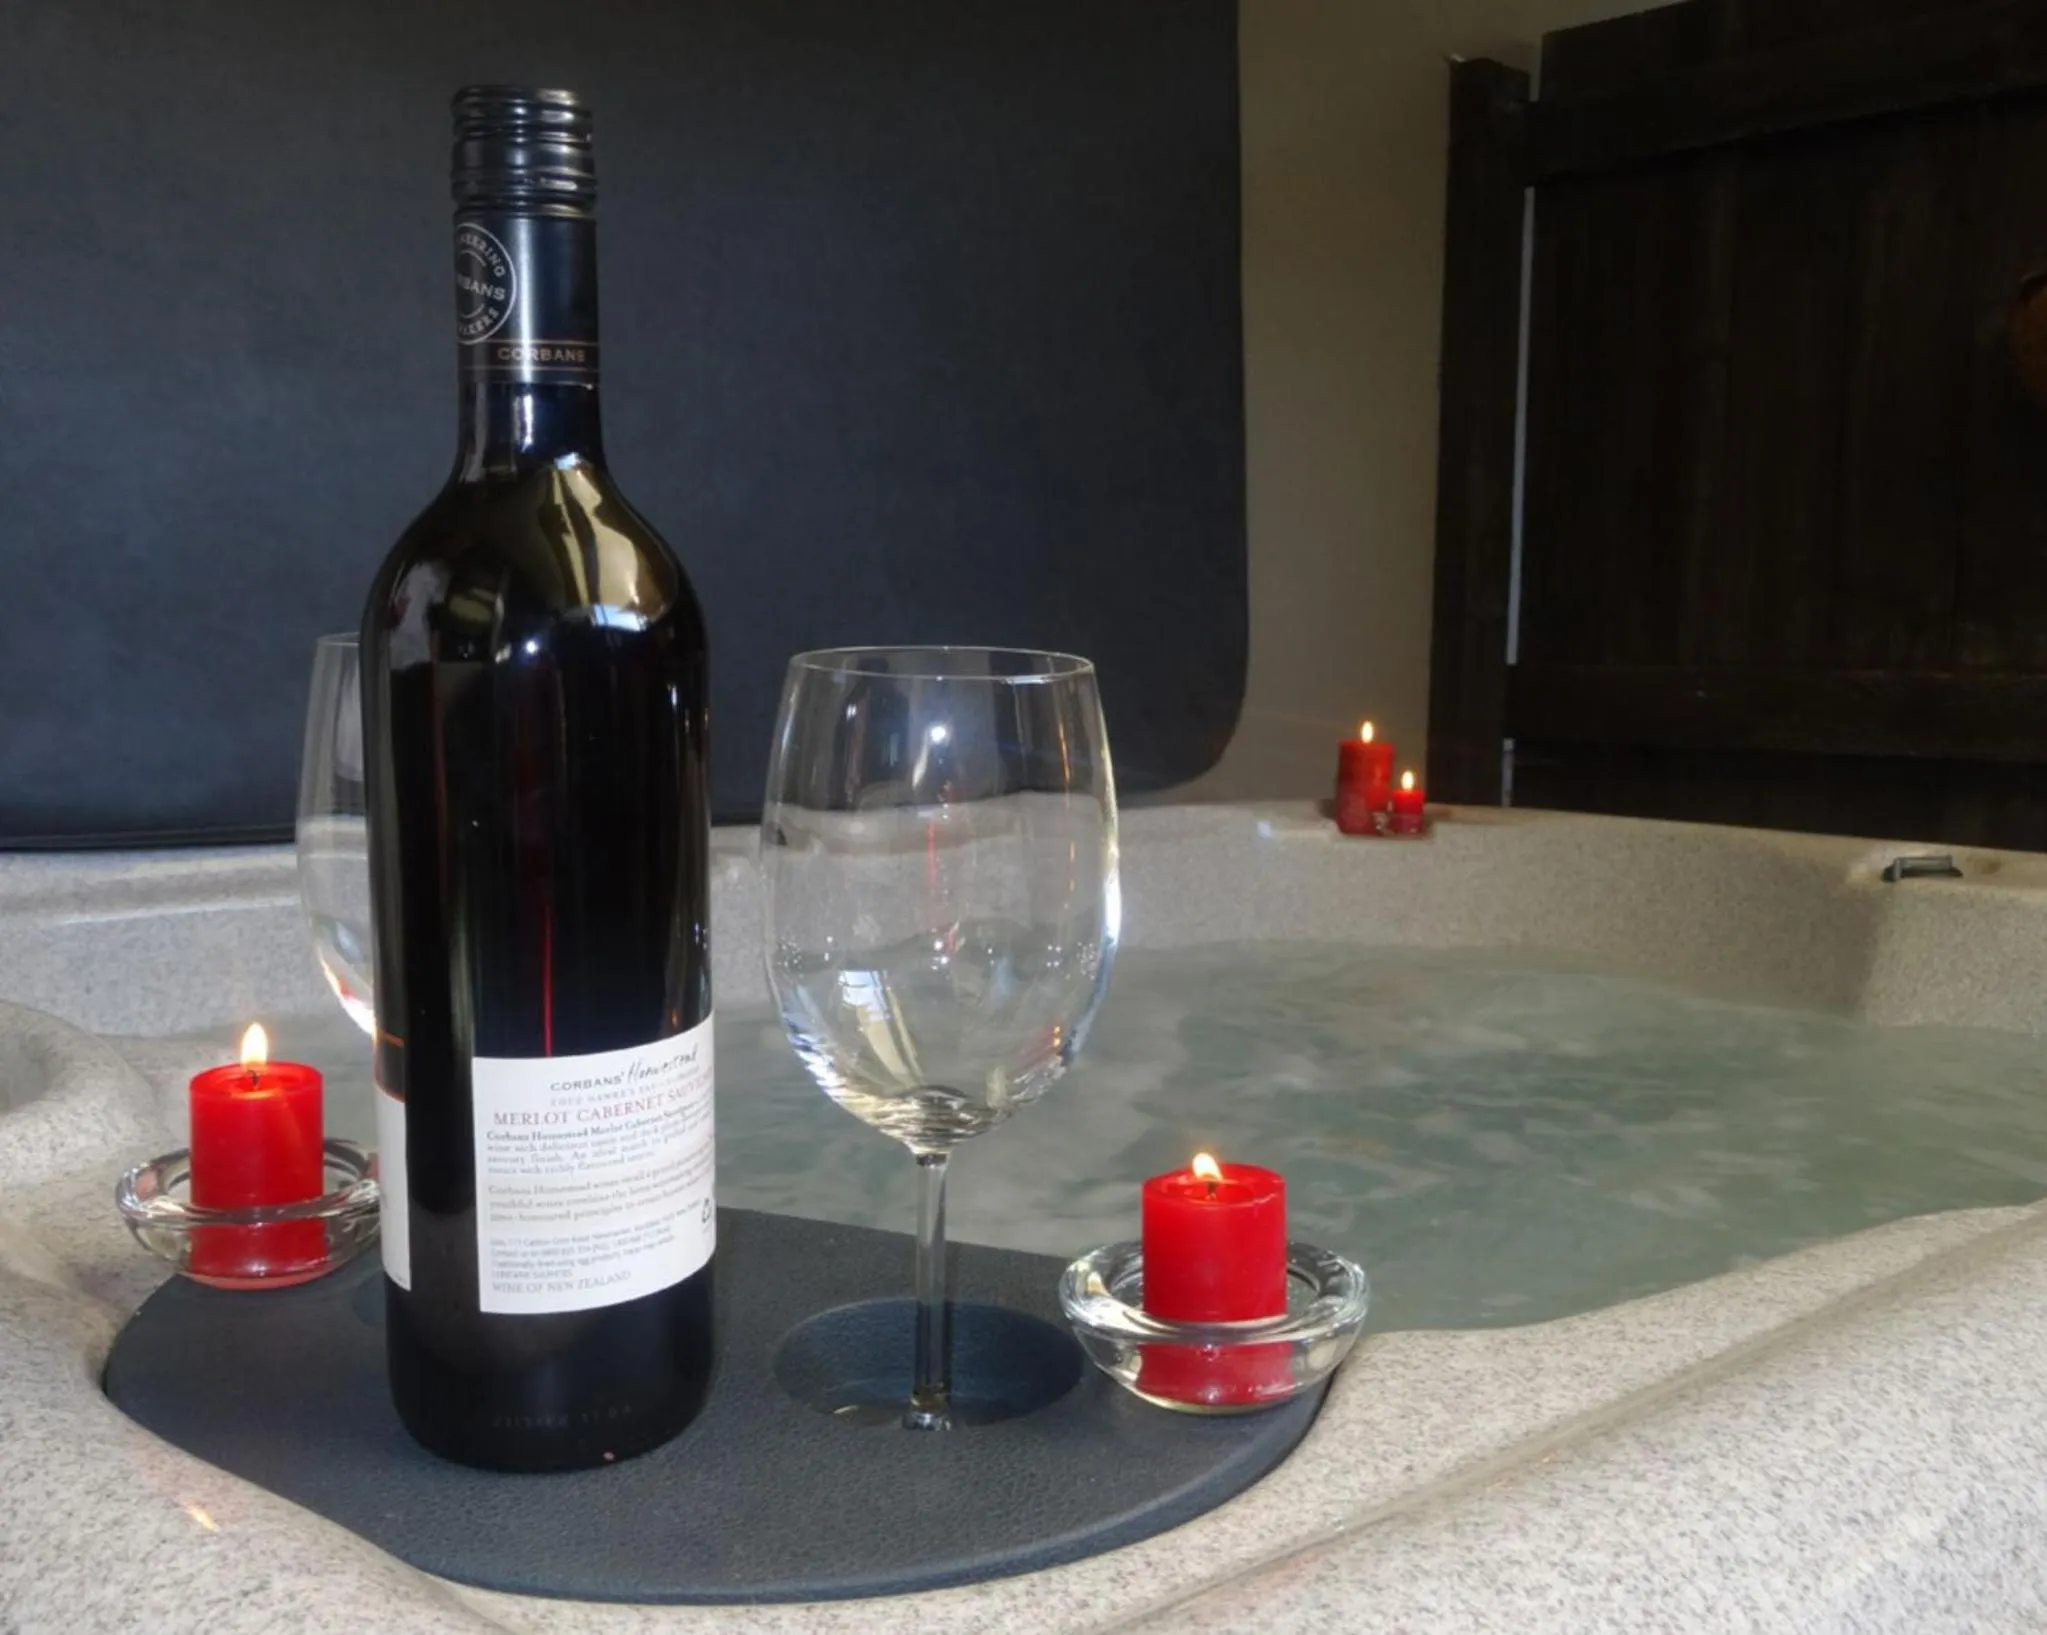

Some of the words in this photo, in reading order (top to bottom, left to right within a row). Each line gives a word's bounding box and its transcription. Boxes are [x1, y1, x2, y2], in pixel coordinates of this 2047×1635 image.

[497, 347, 586, 362] CORBANS
[493, 1111, 571, 1126] MERLOT
[577, 1093, 664, 1122] CABERNET
[492, 1280, 524, 1294] WINE
[526, 1281, 544, 1294] OF
[577, 1270, 632, 1290] ZEALAND
